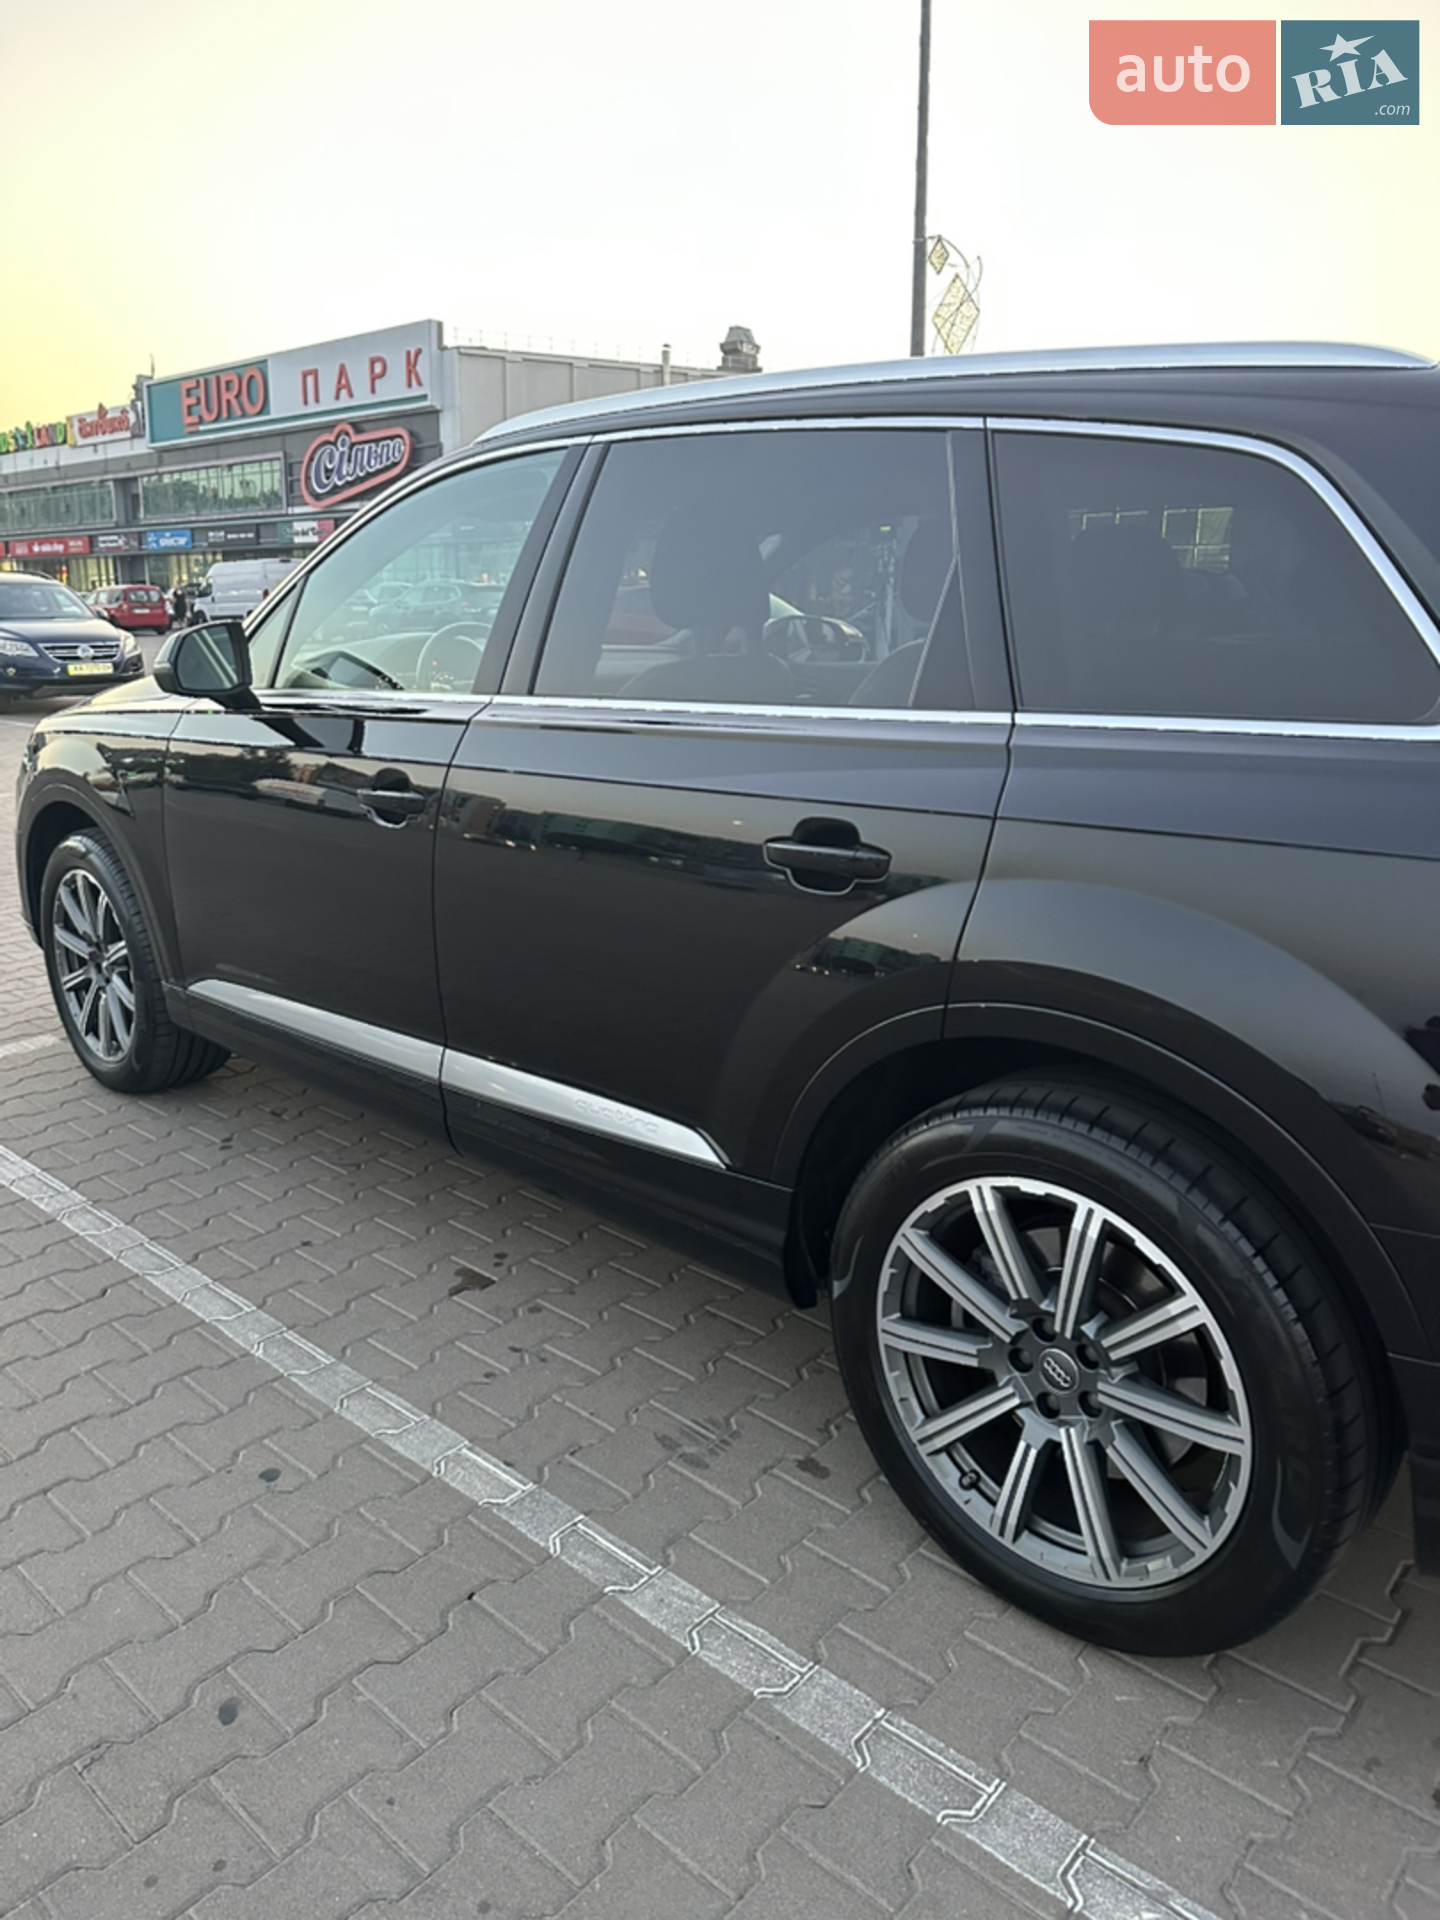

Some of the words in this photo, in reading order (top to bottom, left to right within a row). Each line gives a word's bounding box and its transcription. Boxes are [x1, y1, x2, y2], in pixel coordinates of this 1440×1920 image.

[180, 365, 267, 425] EURO
[300, 347, 424, 406] ПАРК
[310, 433, 405, 494] Сільпо
[574, 1098, 660, 1135] quattro
